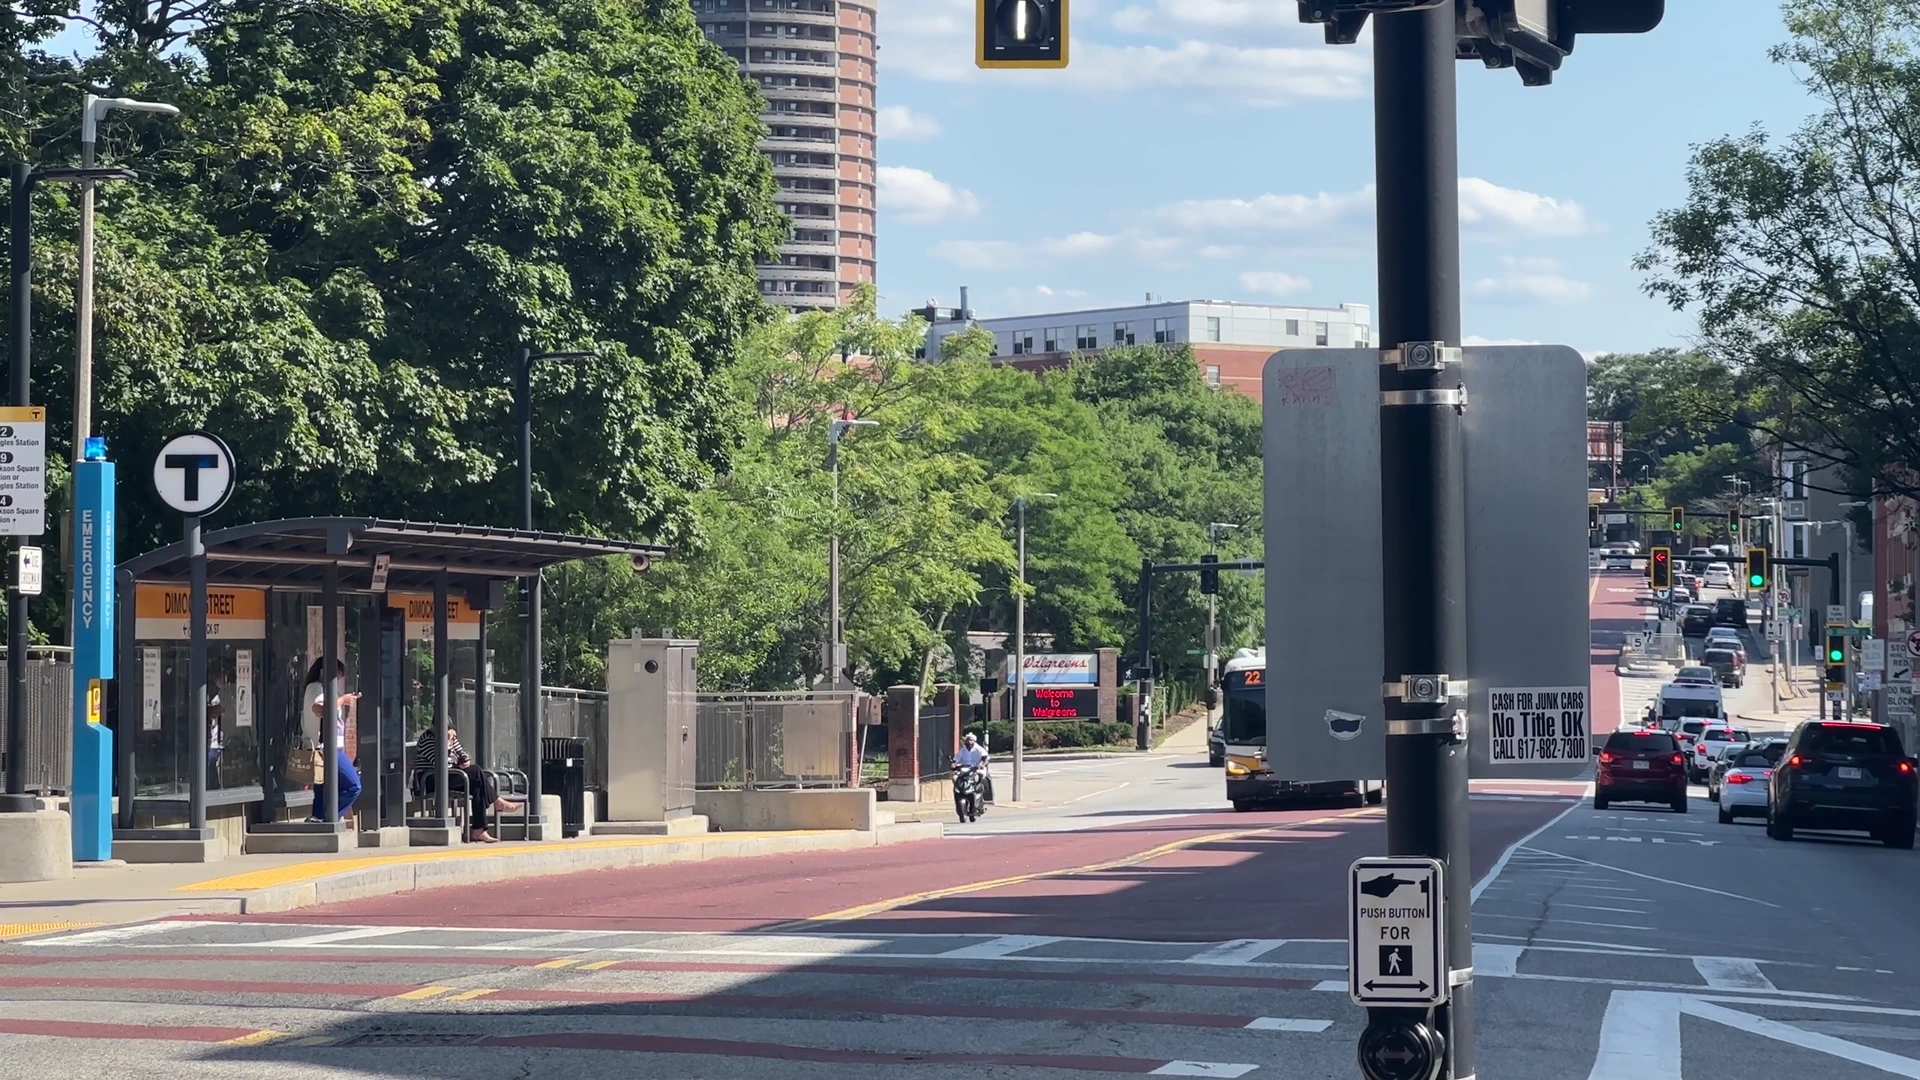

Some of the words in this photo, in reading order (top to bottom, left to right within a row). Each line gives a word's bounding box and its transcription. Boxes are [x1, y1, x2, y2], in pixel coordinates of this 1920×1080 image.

[32, 411, 40, 419] T
[16, 465, 40, 473] Square
[165, 454, 219, 501] T
[16, 507, 40, 516] Square
[82, 509, 93, 629] EMERGENCY
[213, 623, 220, 635] ST
[1023, 656, 1088, 672] Walgreens
[1244, 670, 1261, 686] 22
[1035, 688, 1075, 699] Welcome
[1050, 699, 1060, 707] to
[1492, 692, 1514, 712] CA$H
[1517, 693, 1533, 711] FOR
[1535, 692, 1559, 710] JUNK
[1561, 690, 1584, 711] CAR$
[1032, 707, 1078, 718] Walgreens
[1493, 712, 1515, 738] No
[1520, 712, 1555, 737] Title
[1561, 711, 1584, 737] OK
[1493, 739, 1515, 759] CALL
[1518, 738, 1585, 759] 617-682-7300
[1361, 908, 1386, 918] PUSH
[1389, 908, 1425, 918] BUTTON
[1381, 926, 1410, 940] FOR
